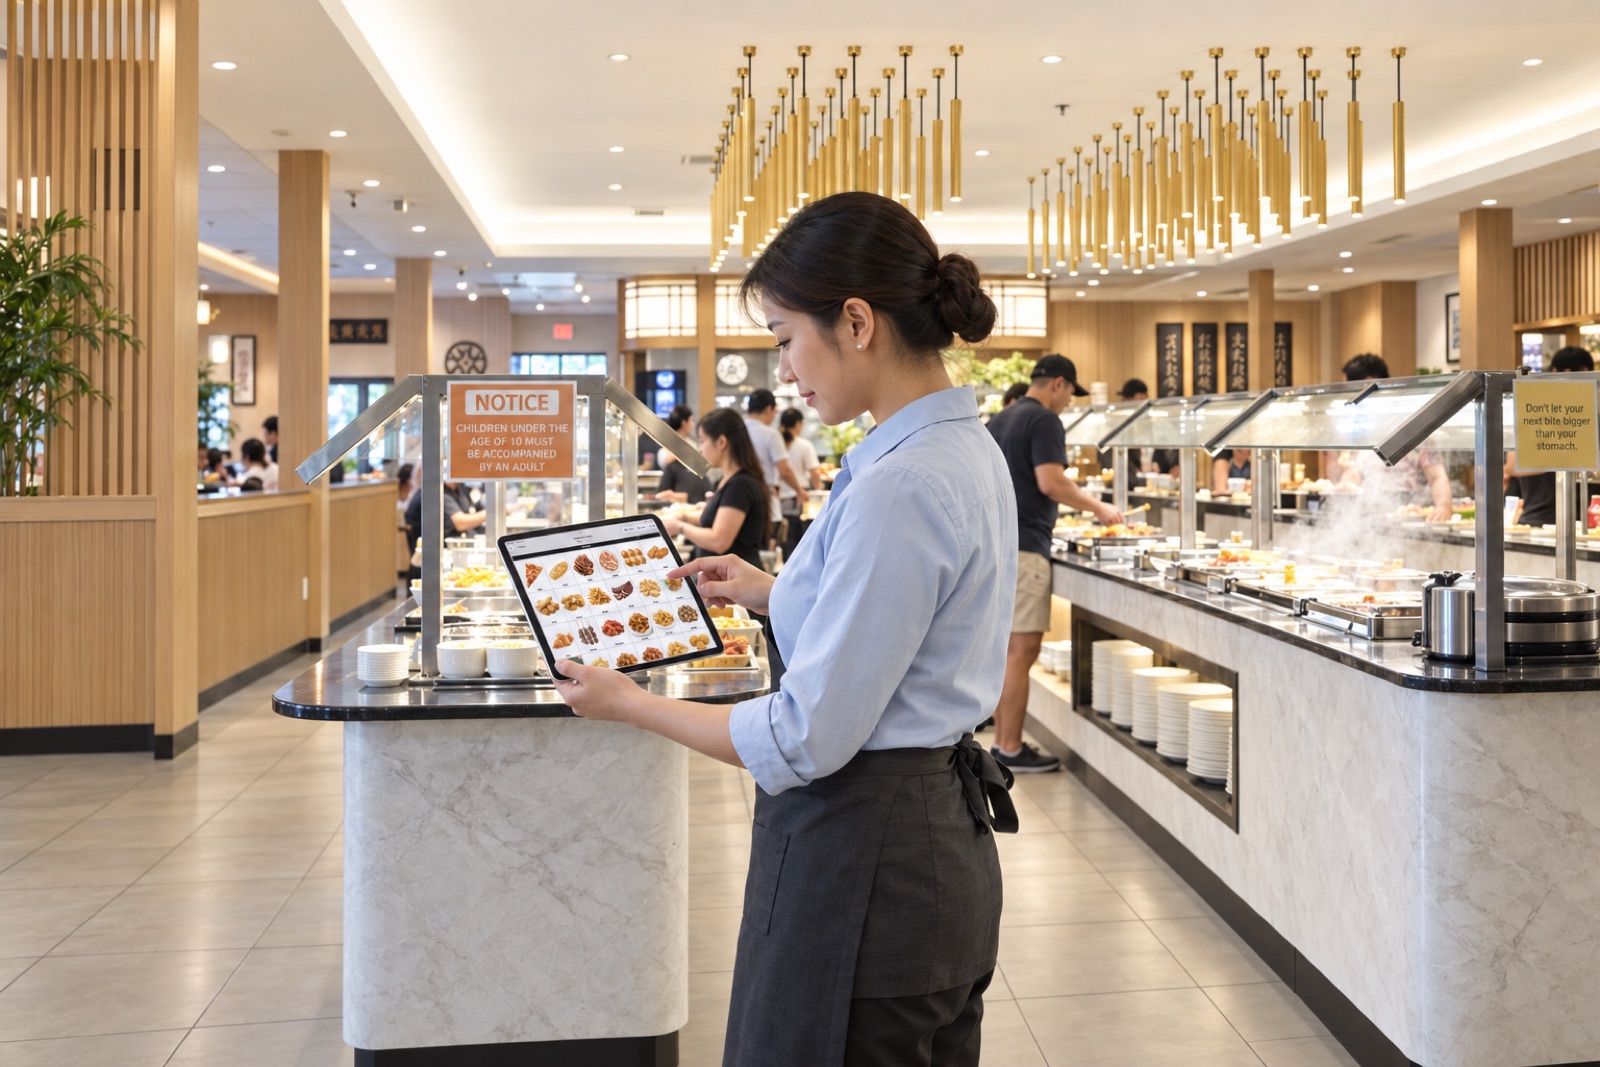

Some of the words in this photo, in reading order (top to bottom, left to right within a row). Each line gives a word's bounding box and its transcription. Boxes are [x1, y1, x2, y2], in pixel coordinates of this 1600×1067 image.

[476, 394, 549, 411] NOTICE
[1526, 404, 1549, 413] Don't
[1551, 404, 1562, 413] let
[1565, 405, 1584, 415] your
[1545, 417, 1560, 425] bite
[1563, 417, 1590, 427] bigger
[456, 424, 508, 432] CHILDREN
[511, 424, 546, 432] UNDER
[549, 424, 568, 432] THE
[1535, 429, 1555, 438] than
[1558, 430, 1577, 439] your
[470, 438, 490, 446] AGE
[494, 438, 507, 446] OF
[511, 438, 522, 446] 10
[525, 437, 554, 446] MUST
[1537, 442, 1577, 450] stomach.
[468, 450, 479, 458] BE
[483, 450, 556, 458] ACCOMPANIED
[480, 463, 492, 471] BY
[495, 463, 508, 471] AN
[512, 463, 545, 471] ADULT
